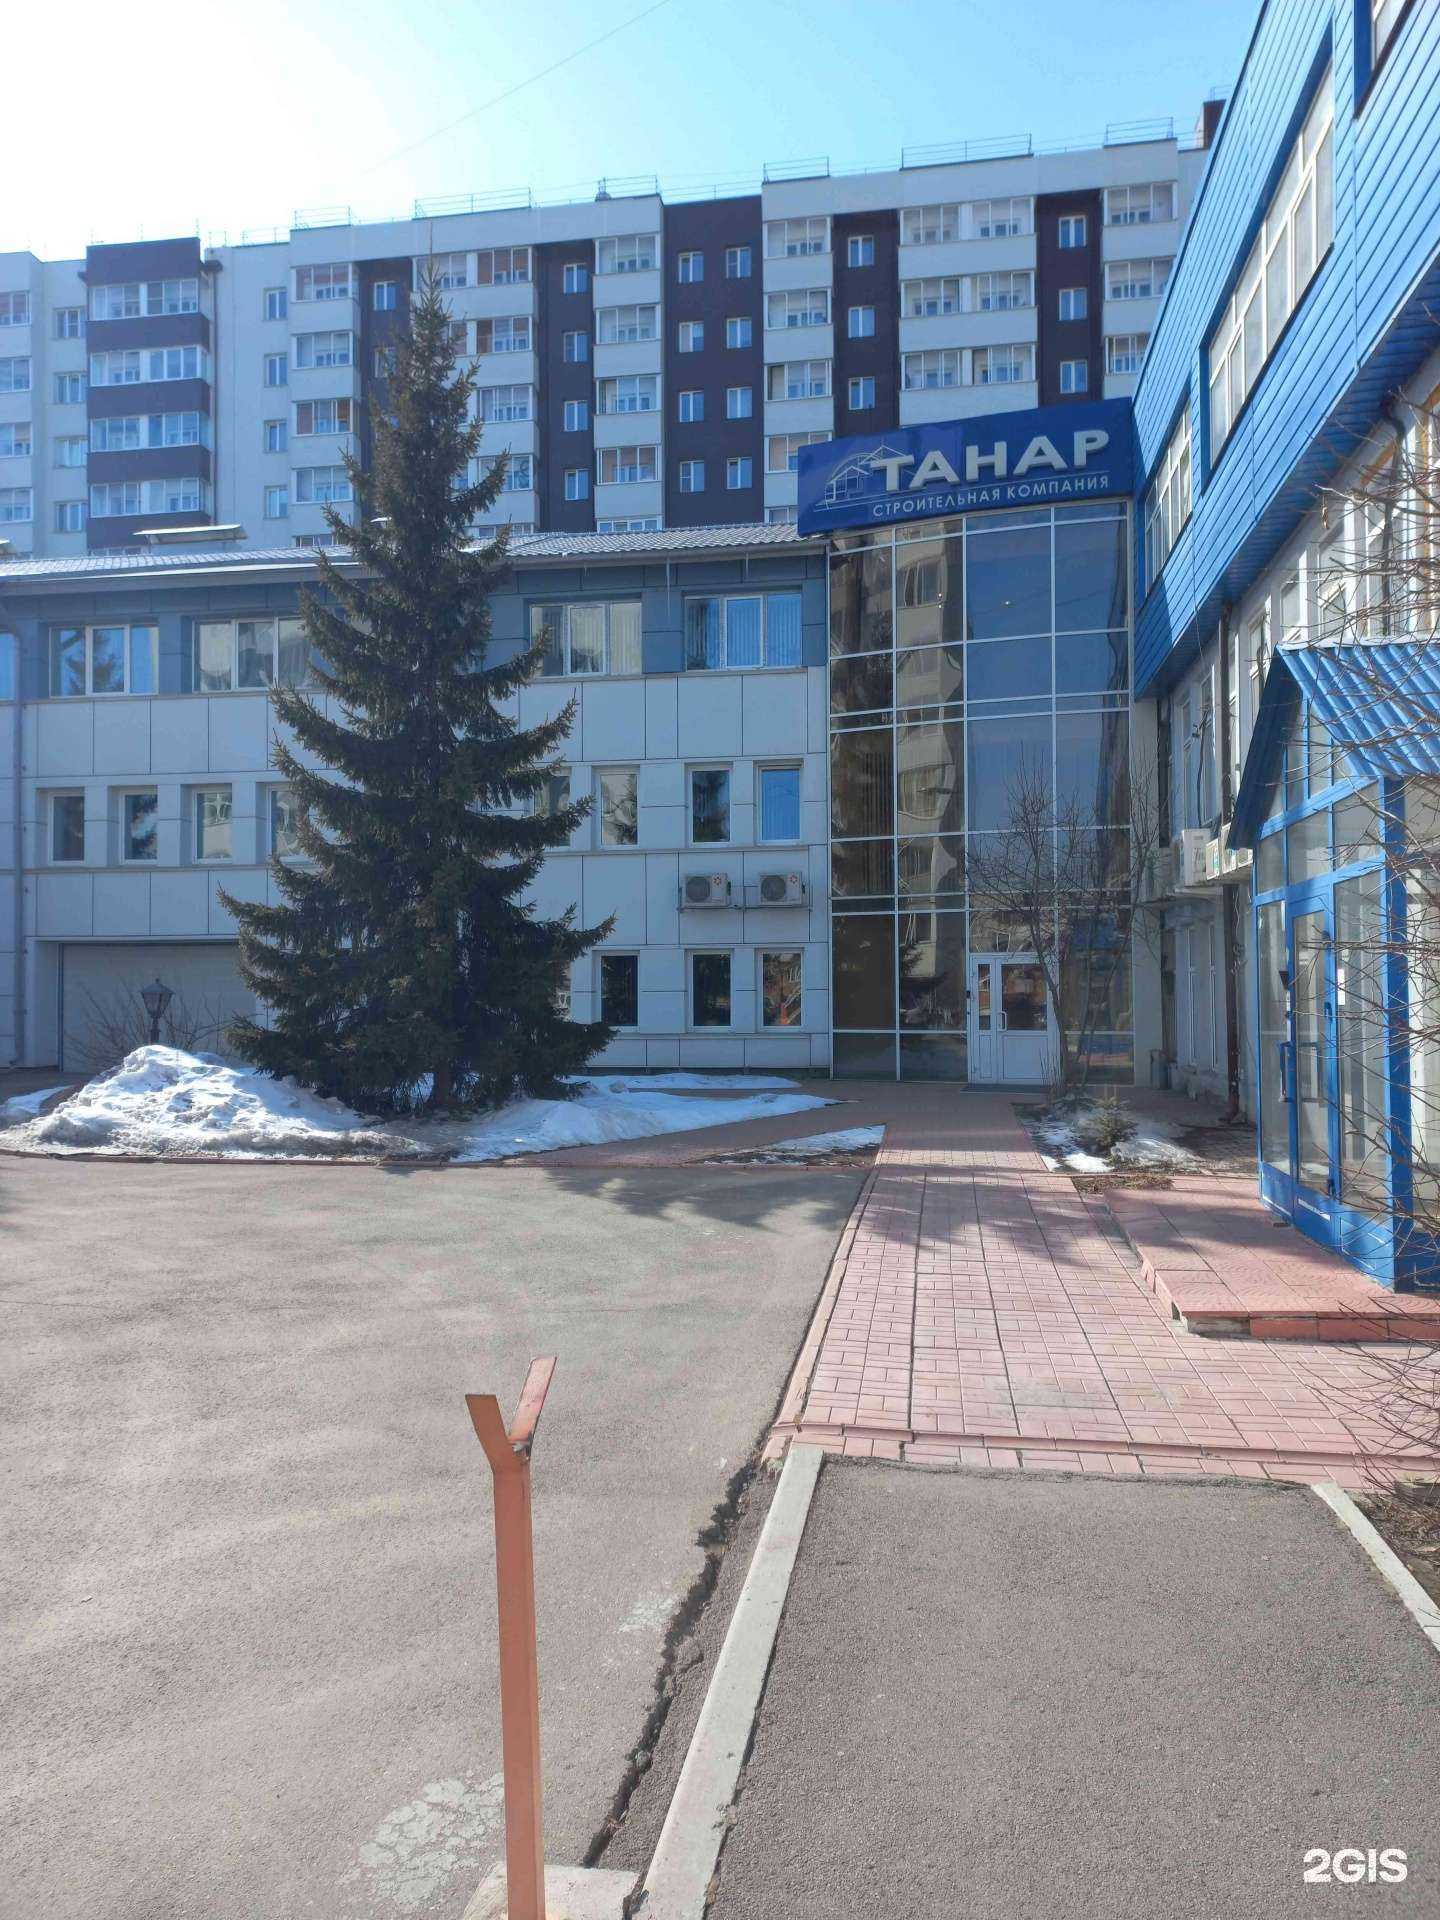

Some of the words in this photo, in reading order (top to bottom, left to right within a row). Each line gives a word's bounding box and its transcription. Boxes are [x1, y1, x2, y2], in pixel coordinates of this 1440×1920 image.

[870, 430, 1110, 493] ТАНАР
[873, 488, 1001, 518] СТРОИТЕЛЬНАЯ
[1007, 475, 1109, 500] КОМПАНИЯ
